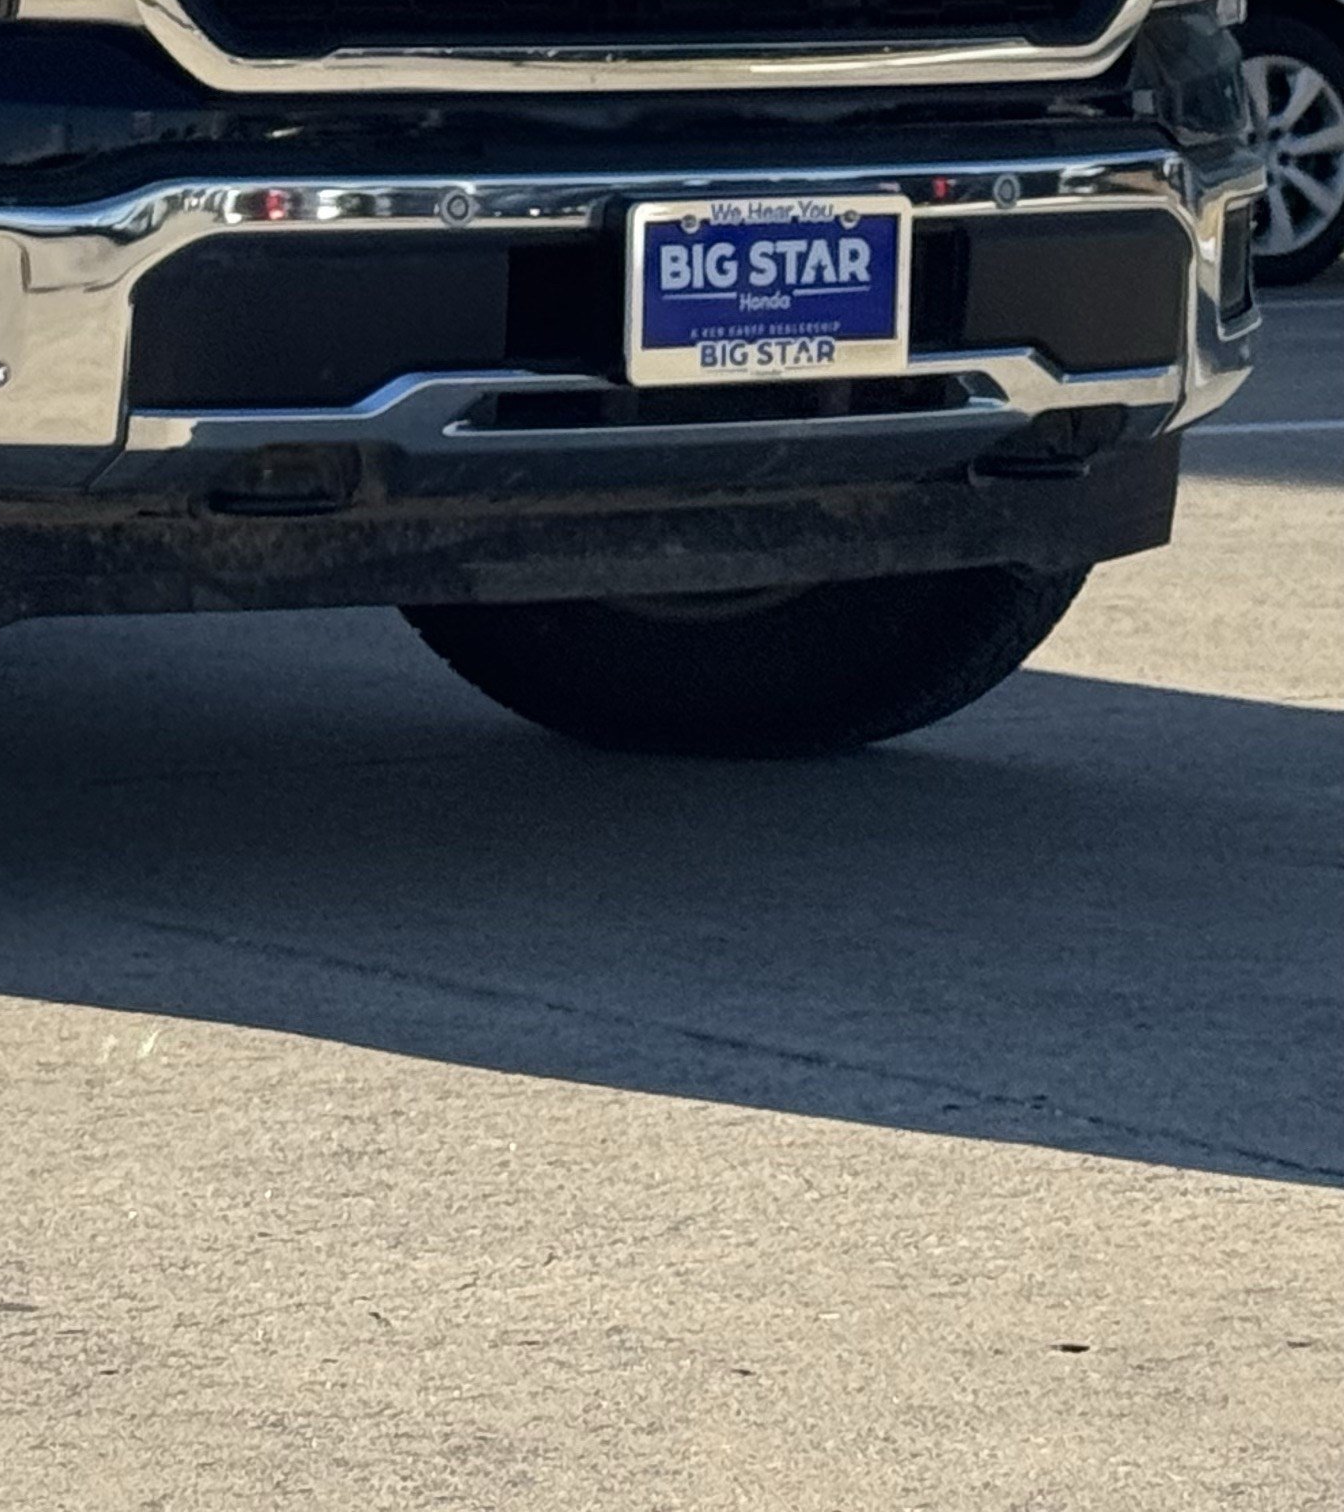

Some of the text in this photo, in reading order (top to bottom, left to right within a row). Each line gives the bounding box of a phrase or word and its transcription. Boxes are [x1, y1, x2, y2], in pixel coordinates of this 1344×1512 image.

[712, 200, 834, 221] We Hear You
[662, 237, 871, 289] BIG STAR
[739, 290, 791, 311] Honda
[700, 339, 835, 367] BIG STAR
